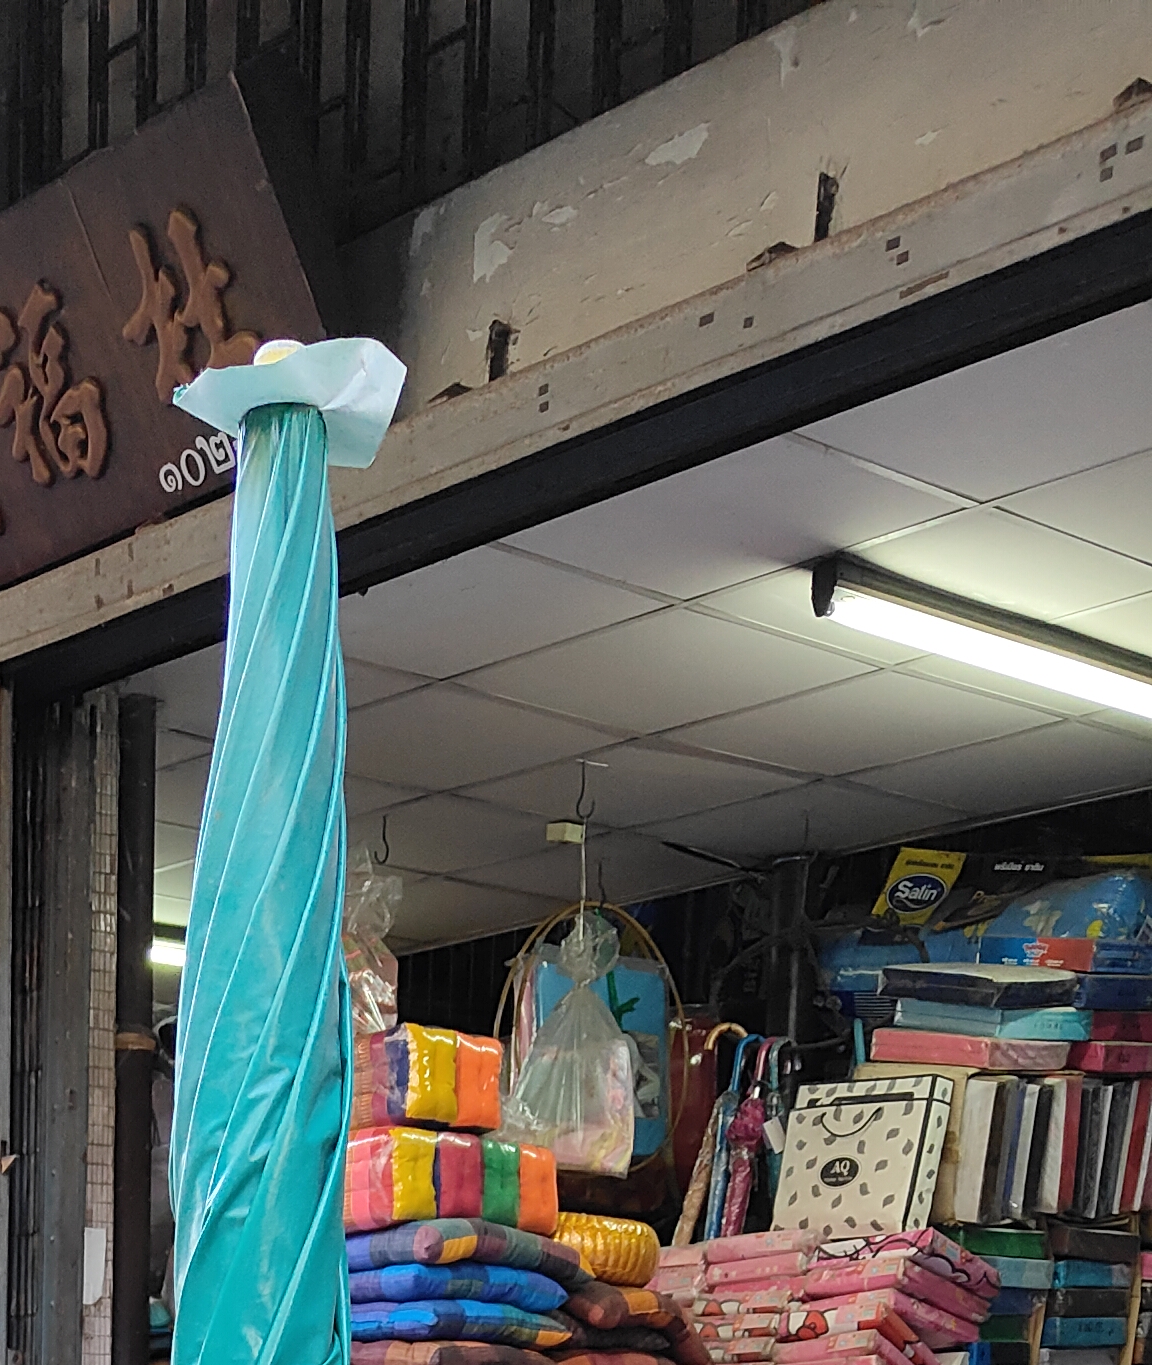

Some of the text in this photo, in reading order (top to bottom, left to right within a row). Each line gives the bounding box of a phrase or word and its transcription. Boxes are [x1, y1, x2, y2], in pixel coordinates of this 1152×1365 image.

[158, 431, 238, 493] ๑๐๒
[895, 880, 939, 901] Satin
[829, 1160, 850, 1176] AQ
